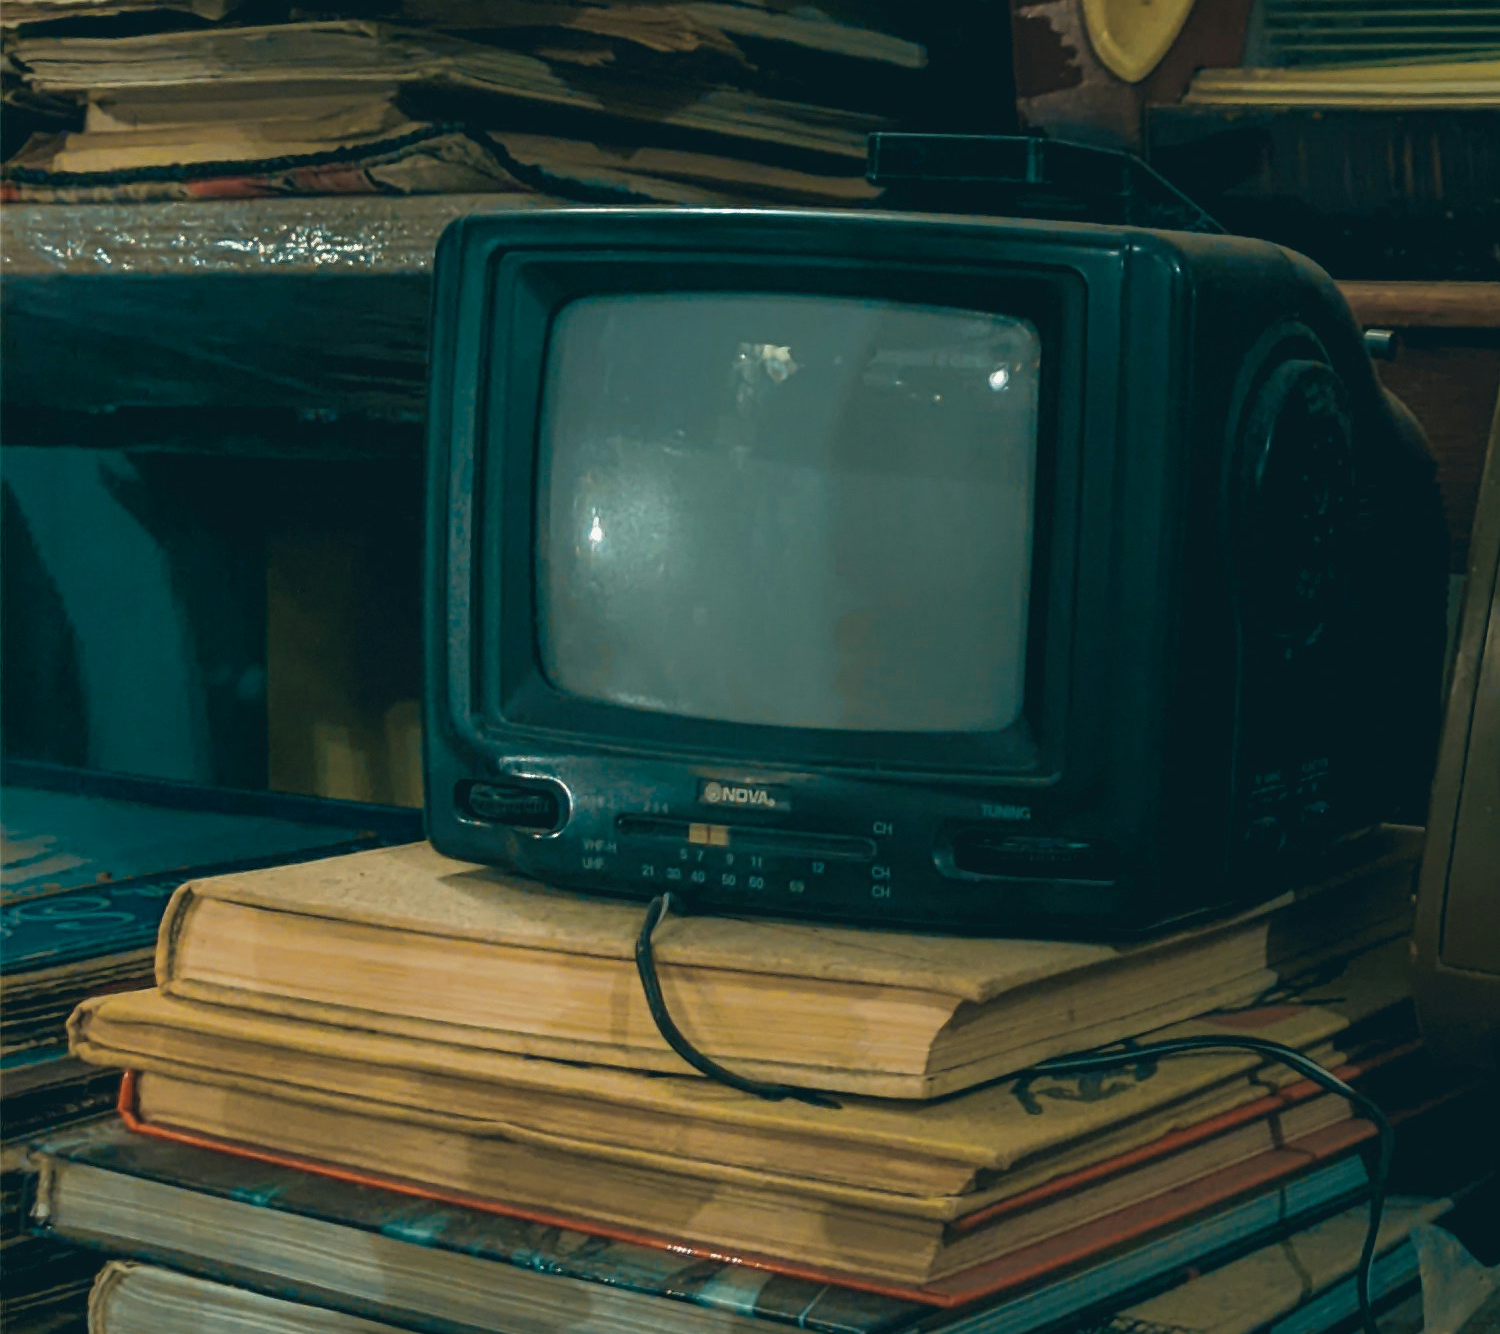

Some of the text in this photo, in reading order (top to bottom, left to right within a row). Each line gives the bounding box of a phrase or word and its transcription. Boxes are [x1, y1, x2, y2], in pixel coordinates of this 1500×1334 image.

[721, 786, 770, 805] NOVA
[981, 803, 1031, 820] TUNING
[872, 821, 893, 836] CH
[871, 865, 891, 880] CH
[871, 884, 891, 898] CH
